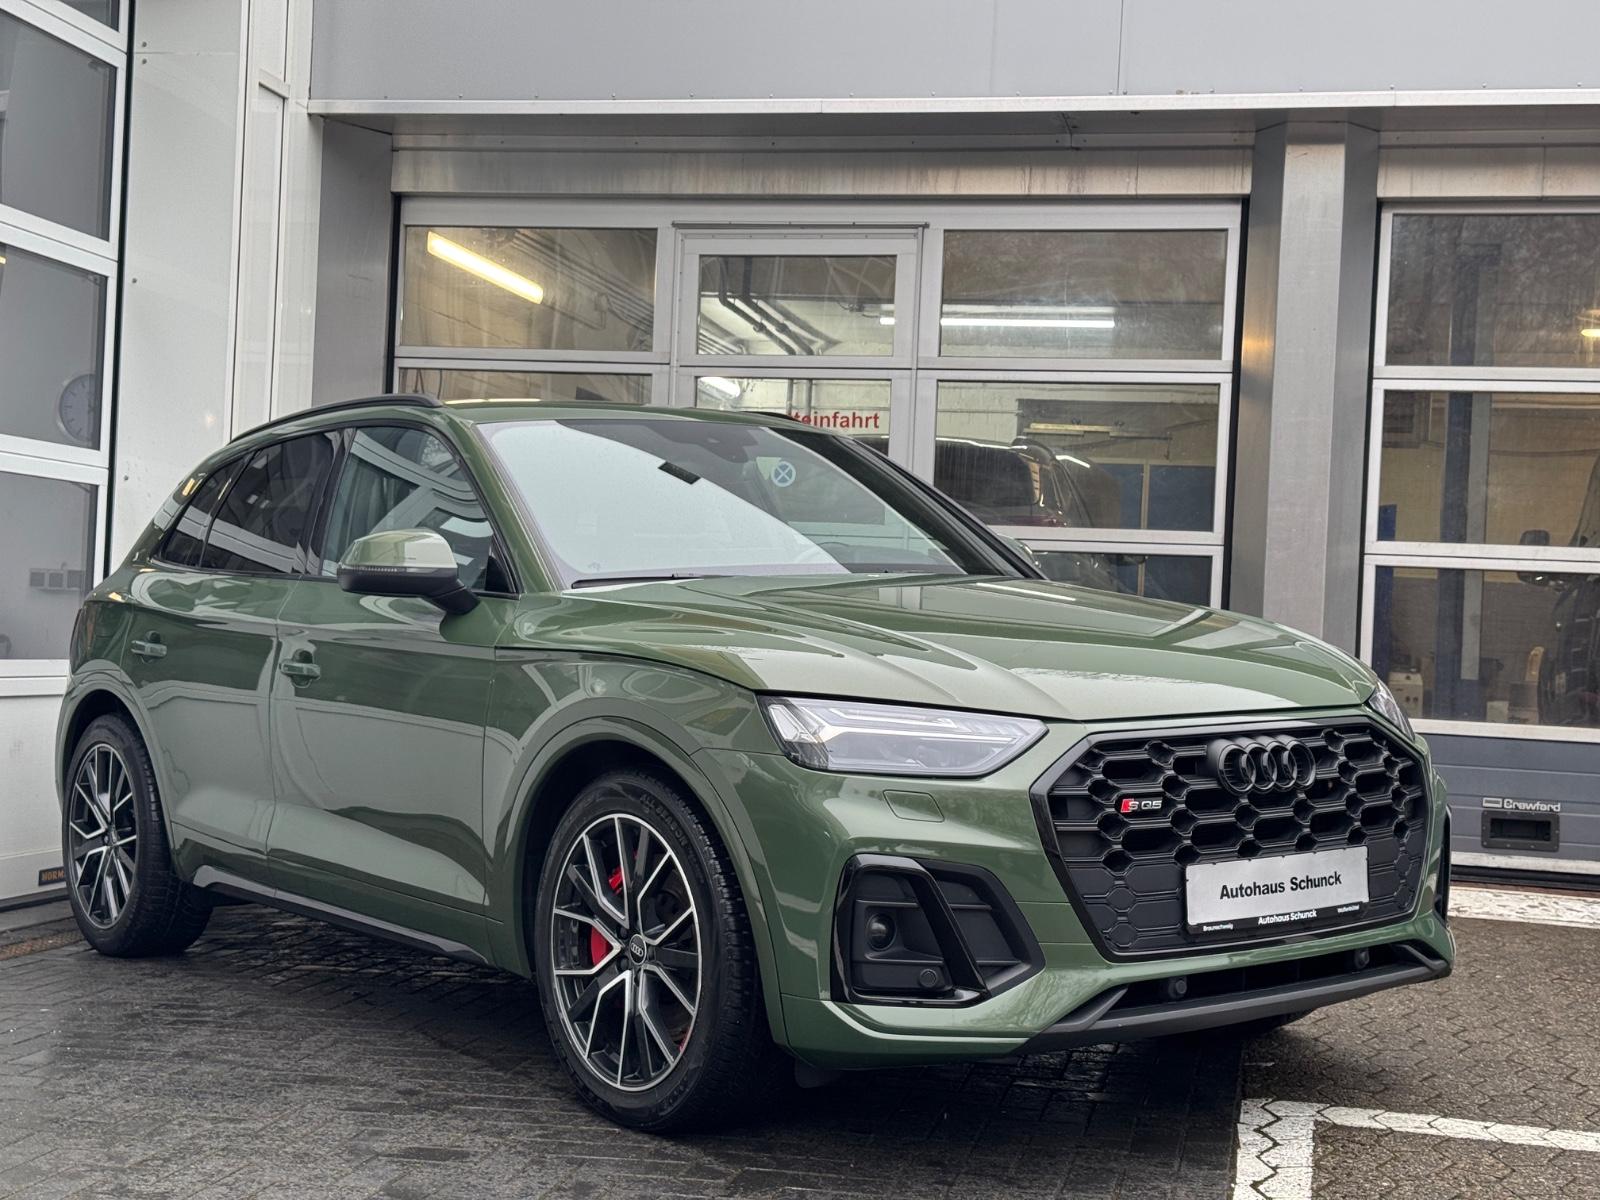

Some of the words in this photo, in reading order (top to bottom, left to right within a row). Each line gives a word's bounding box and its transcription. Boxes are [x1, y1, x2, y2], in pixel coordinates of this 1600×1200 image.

[788, 411, 880, 428] einfahrt
[1127, 799, 1162, 810] SQ5
[1504, 799, 1561, 812] Crawford
[1220, 882, 1285, 899] Autohaus
[1290, 871, 1342, 892] Schunck
[1258, 913, 1289, 925] Autohaus
[1290, 909, 1317, 921] Schunck
